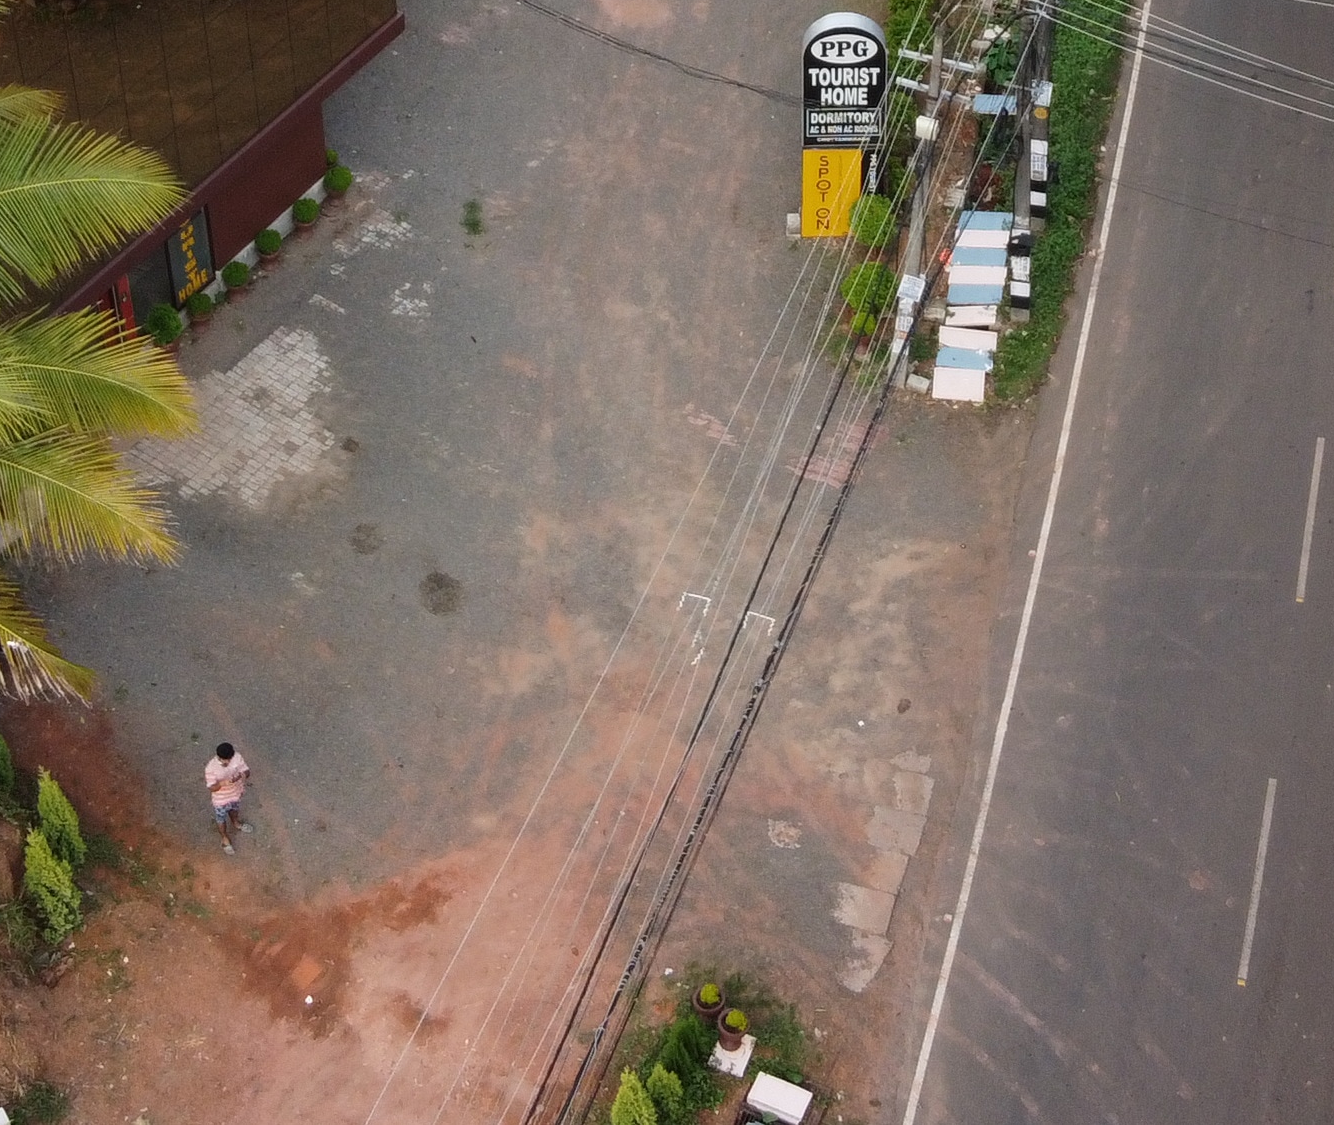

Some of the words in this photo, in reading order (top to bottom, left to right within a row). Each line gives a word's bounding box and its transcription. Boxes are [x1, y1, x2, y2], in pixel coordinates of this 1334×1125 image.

[820, 40, 869, 57] PPG
[808, 67, 880, 86] TOURIST
[821, 87, 868, 106] HOME
[810, 112, 876, 124] DORMITORY
[810, 125, 819, 133] AC
[821, 125, 826, 133] &
[828, 125, 842, 133] NON
[844, 125, 853, 133] AC
[854, 125, 878, 133] ROOMS
[816, 156, 831, 202] SPOT
[816, 208, 830, 230] ON
[178, 269, 208, 303] HOME
